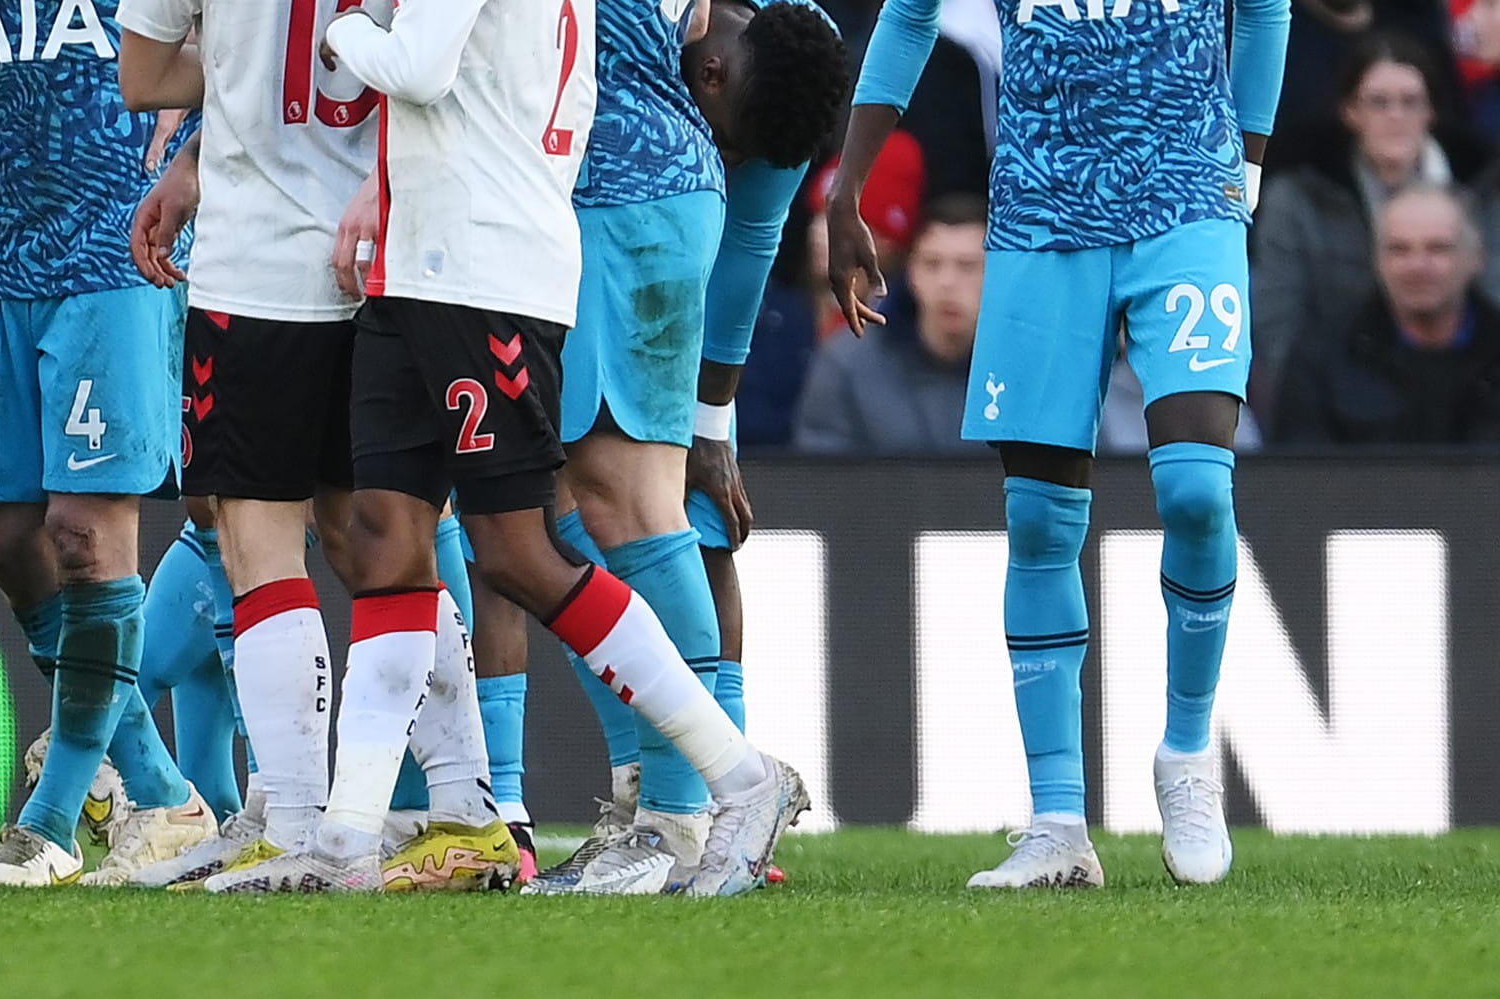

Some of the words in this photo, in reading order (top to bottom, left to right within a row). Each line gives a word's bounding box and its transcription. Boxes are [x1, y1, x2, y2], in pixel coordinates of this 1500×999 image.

[1164, 283, 1243, 354] 29
[65, 379, 106, 450] 4
[445, 378, 495, 455] 2
[314, 655, 327, 713] SFC
